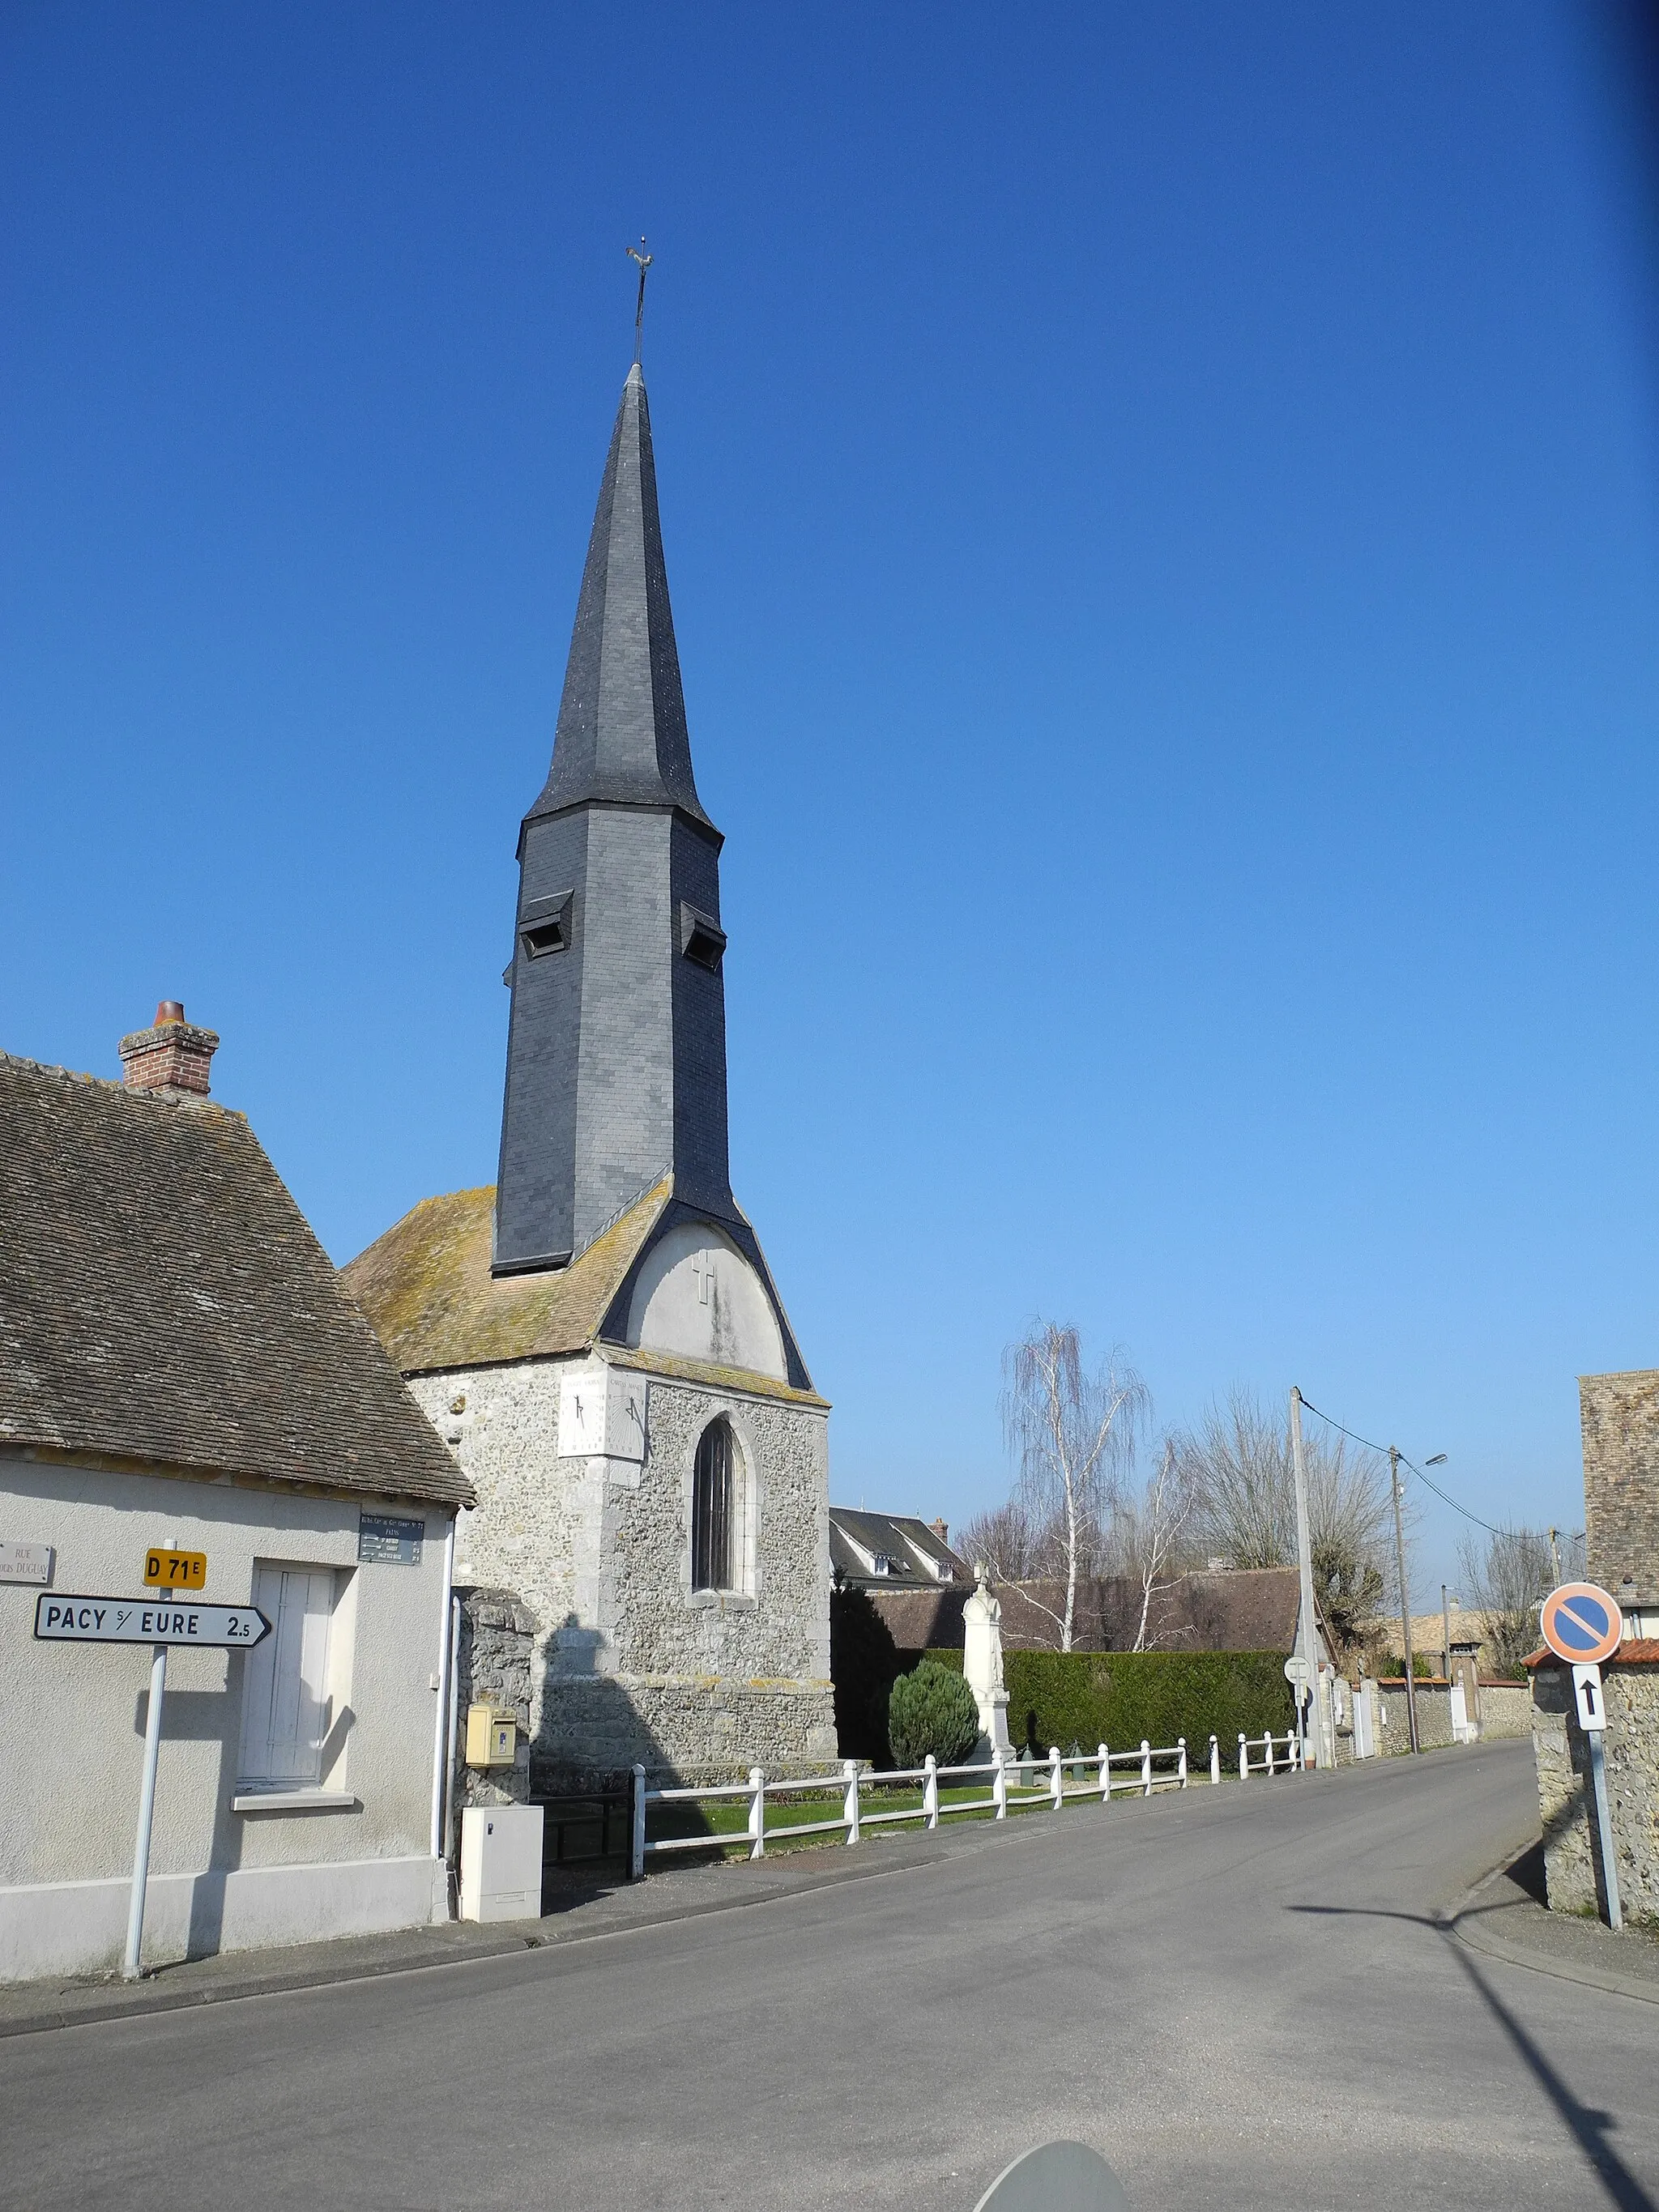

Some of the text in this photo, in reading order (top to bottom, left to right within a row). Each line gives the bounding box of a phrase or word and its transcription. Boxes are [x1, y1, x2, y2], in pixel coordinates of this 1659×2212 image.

[15, 1549, 31, 1558] RUE
[16, 1562, 48, 1575] DUGUAY
[147, 1558, 160, 1577] D
[46, 1606, 107, 1630] PACY
[141, 1612, 198, 1634] EURE
[227, 1617, 250, 1638] 2.5
